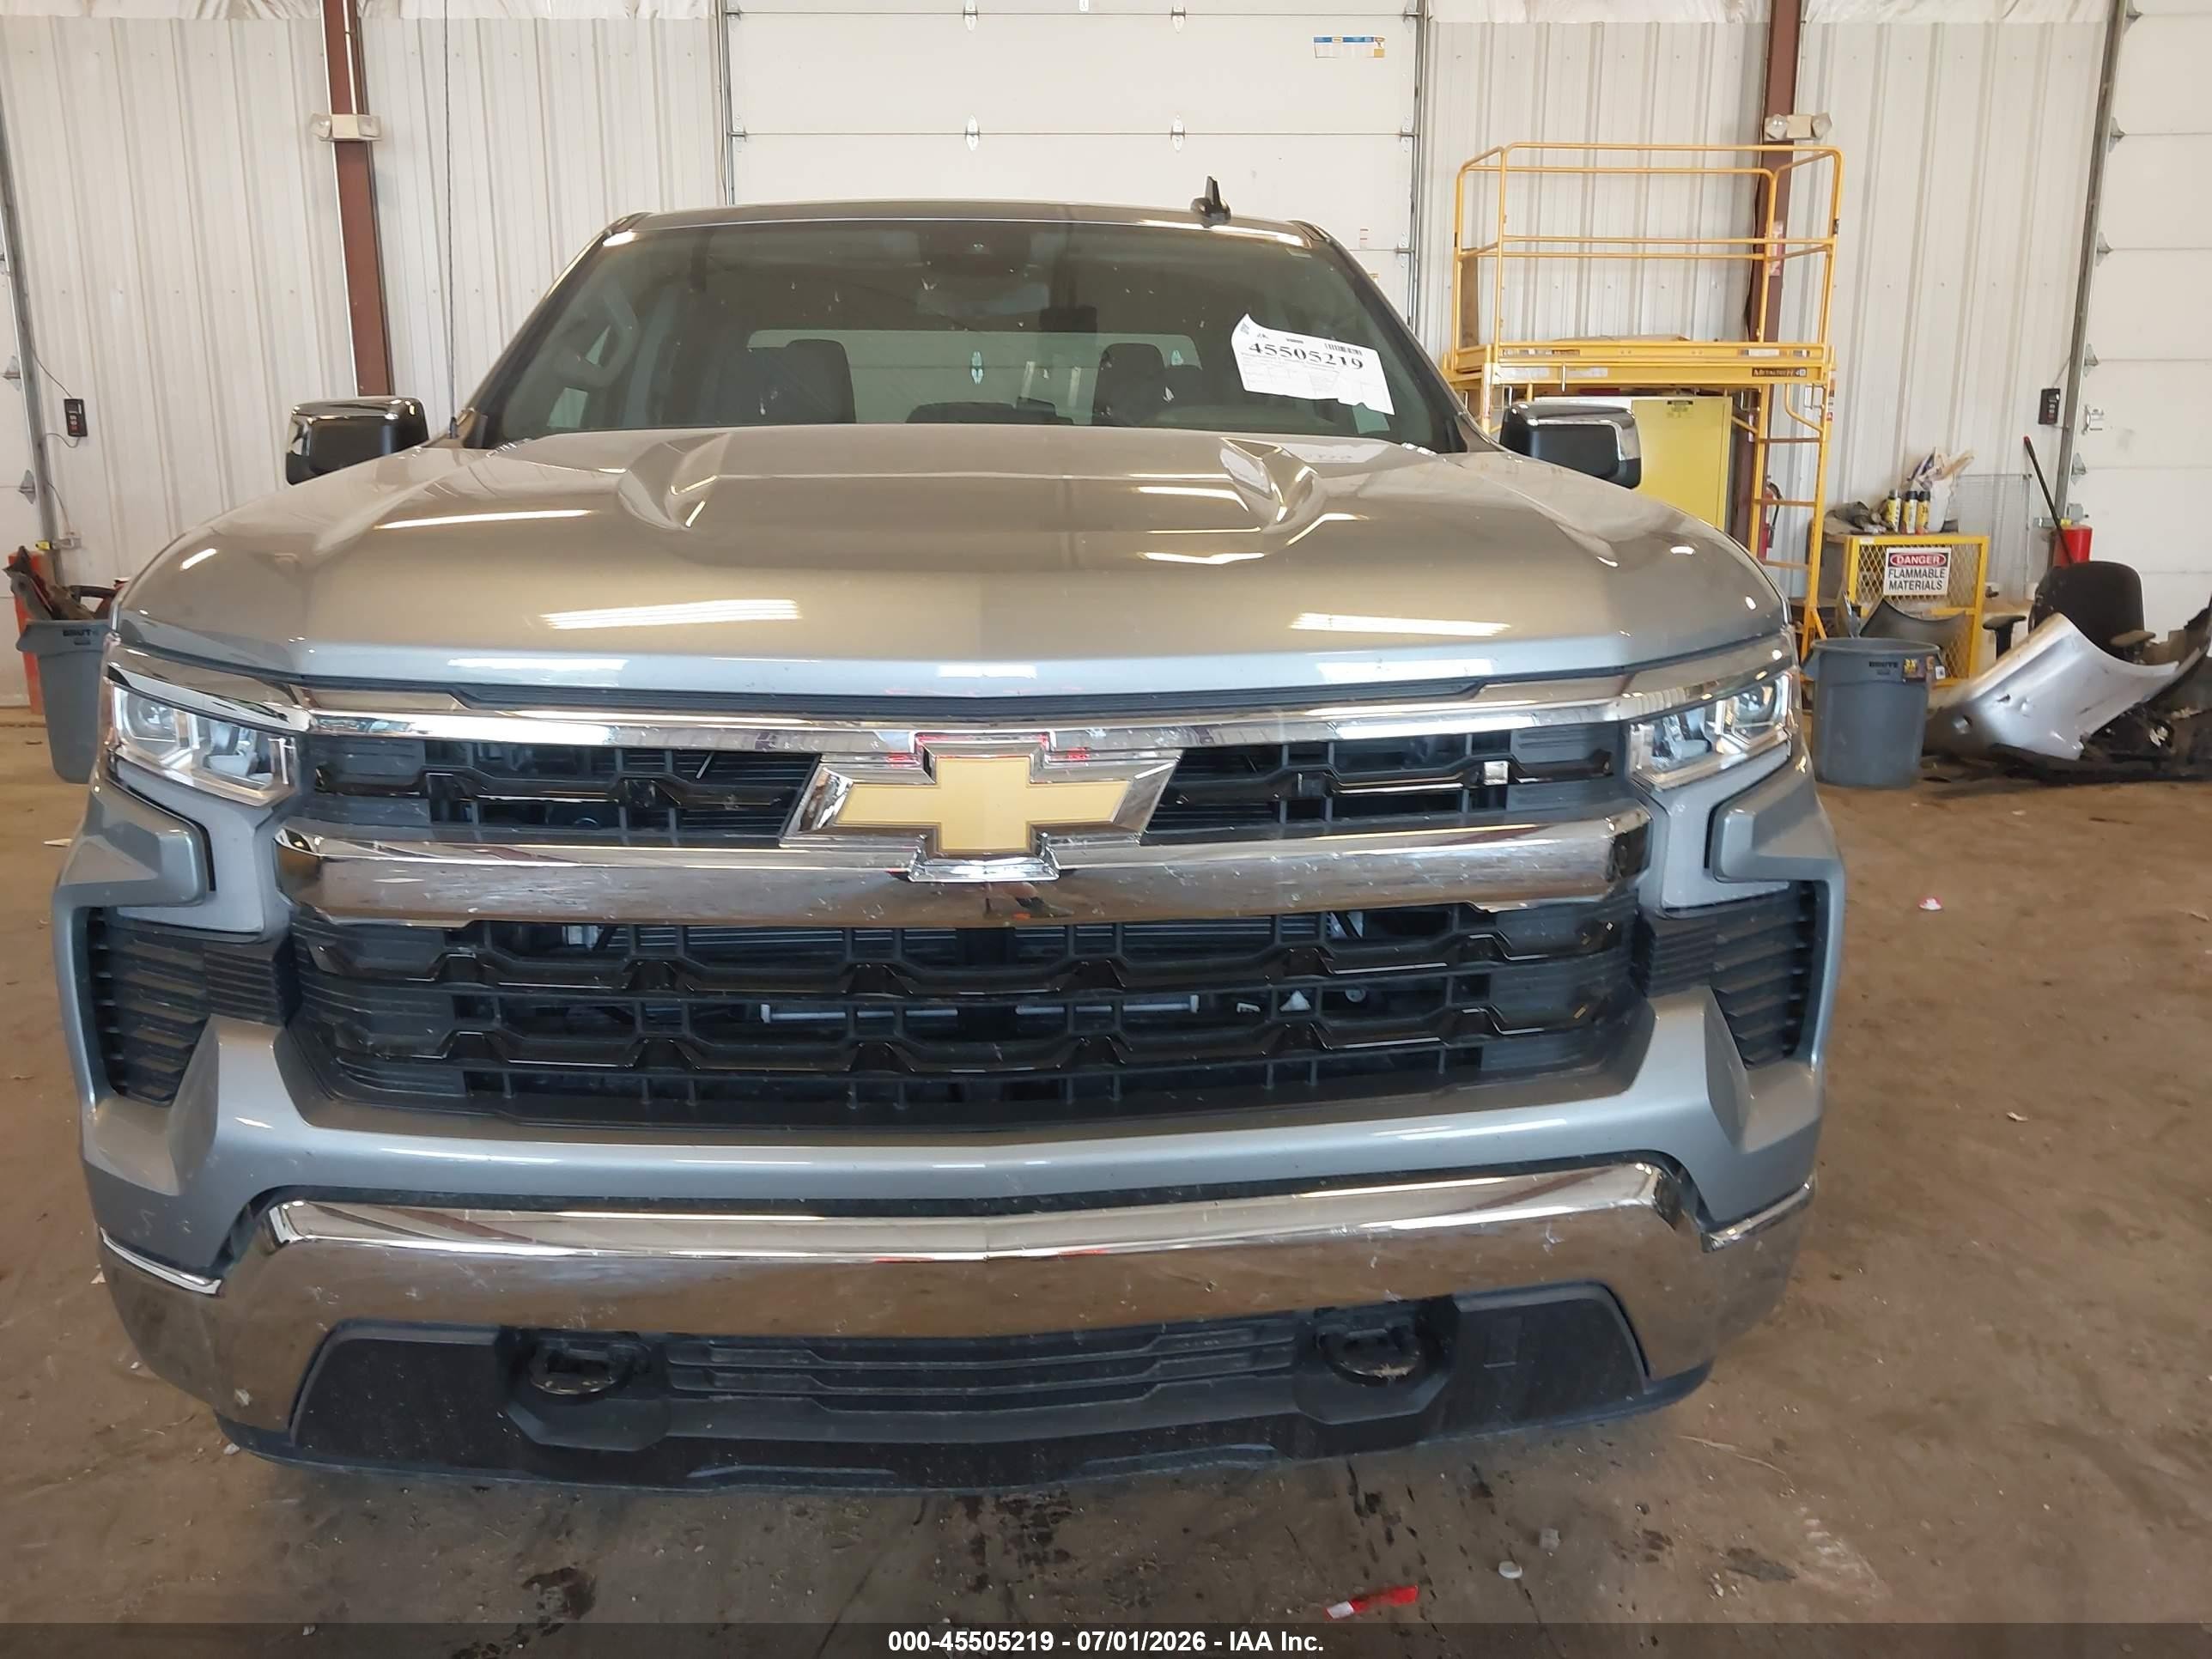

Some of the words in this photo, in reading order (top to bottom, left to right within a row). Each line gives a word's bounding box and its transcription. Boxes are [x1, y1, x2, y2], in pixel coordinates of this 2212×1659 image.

[1249, 343, 1364, 370] 45505219
[1896, 556, 1941, 565] DANGER
[1888, 568, 1946, 579] FLAMMABLE
[1889, 580, 1943, 591] MATERIALS
